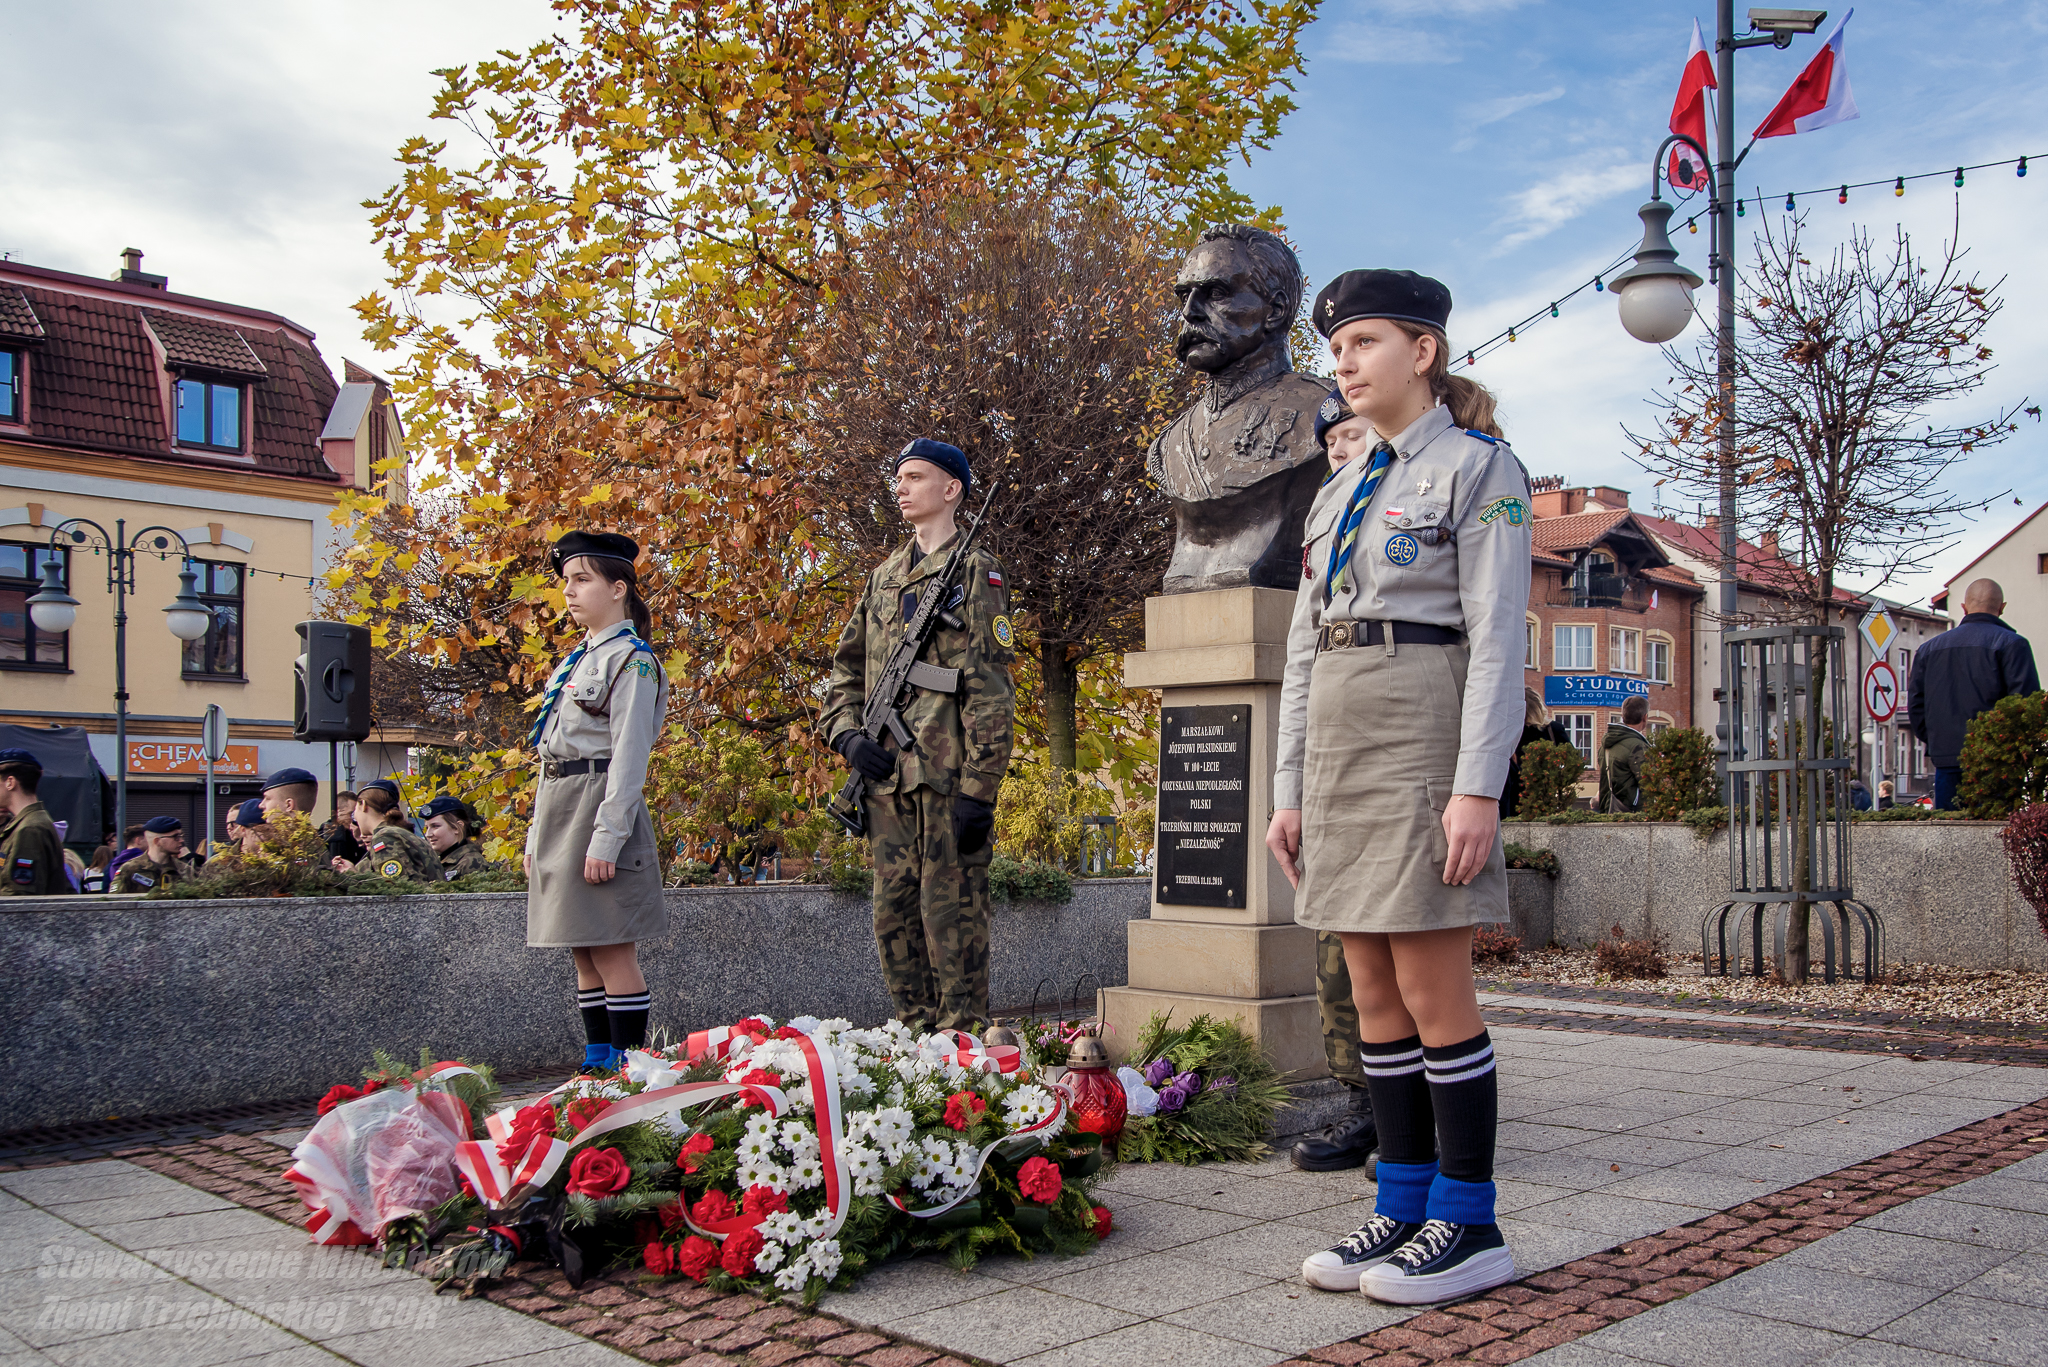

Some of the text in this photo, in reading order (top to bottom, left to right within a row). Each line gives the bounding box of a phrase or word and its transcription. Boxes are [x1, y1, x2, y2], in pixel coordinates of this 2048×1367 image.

[1482, 502, 1502, 519] HUFIEC
[1565, 677, 1621, 690] STUDY
[1181, 725, 1224, 737] MARSZAŁKOWI
[1168, 741, 1237, 755] JÓZEFOWI PIŁSUDSKIEMU
[1184, 762, 1190, 772] W
[1161, 777, 1242, 791] ODZYSKANIA NIEPODLEGŁOŚCI
[1190, 799, 1211, 809] POLSKI
[1160, 820, 1242, 833] TRZEBIŃSKI RUCH SPOŁECZNY
[1175, 874, 1223, 886] TRZEBINIA 11.11.2018
